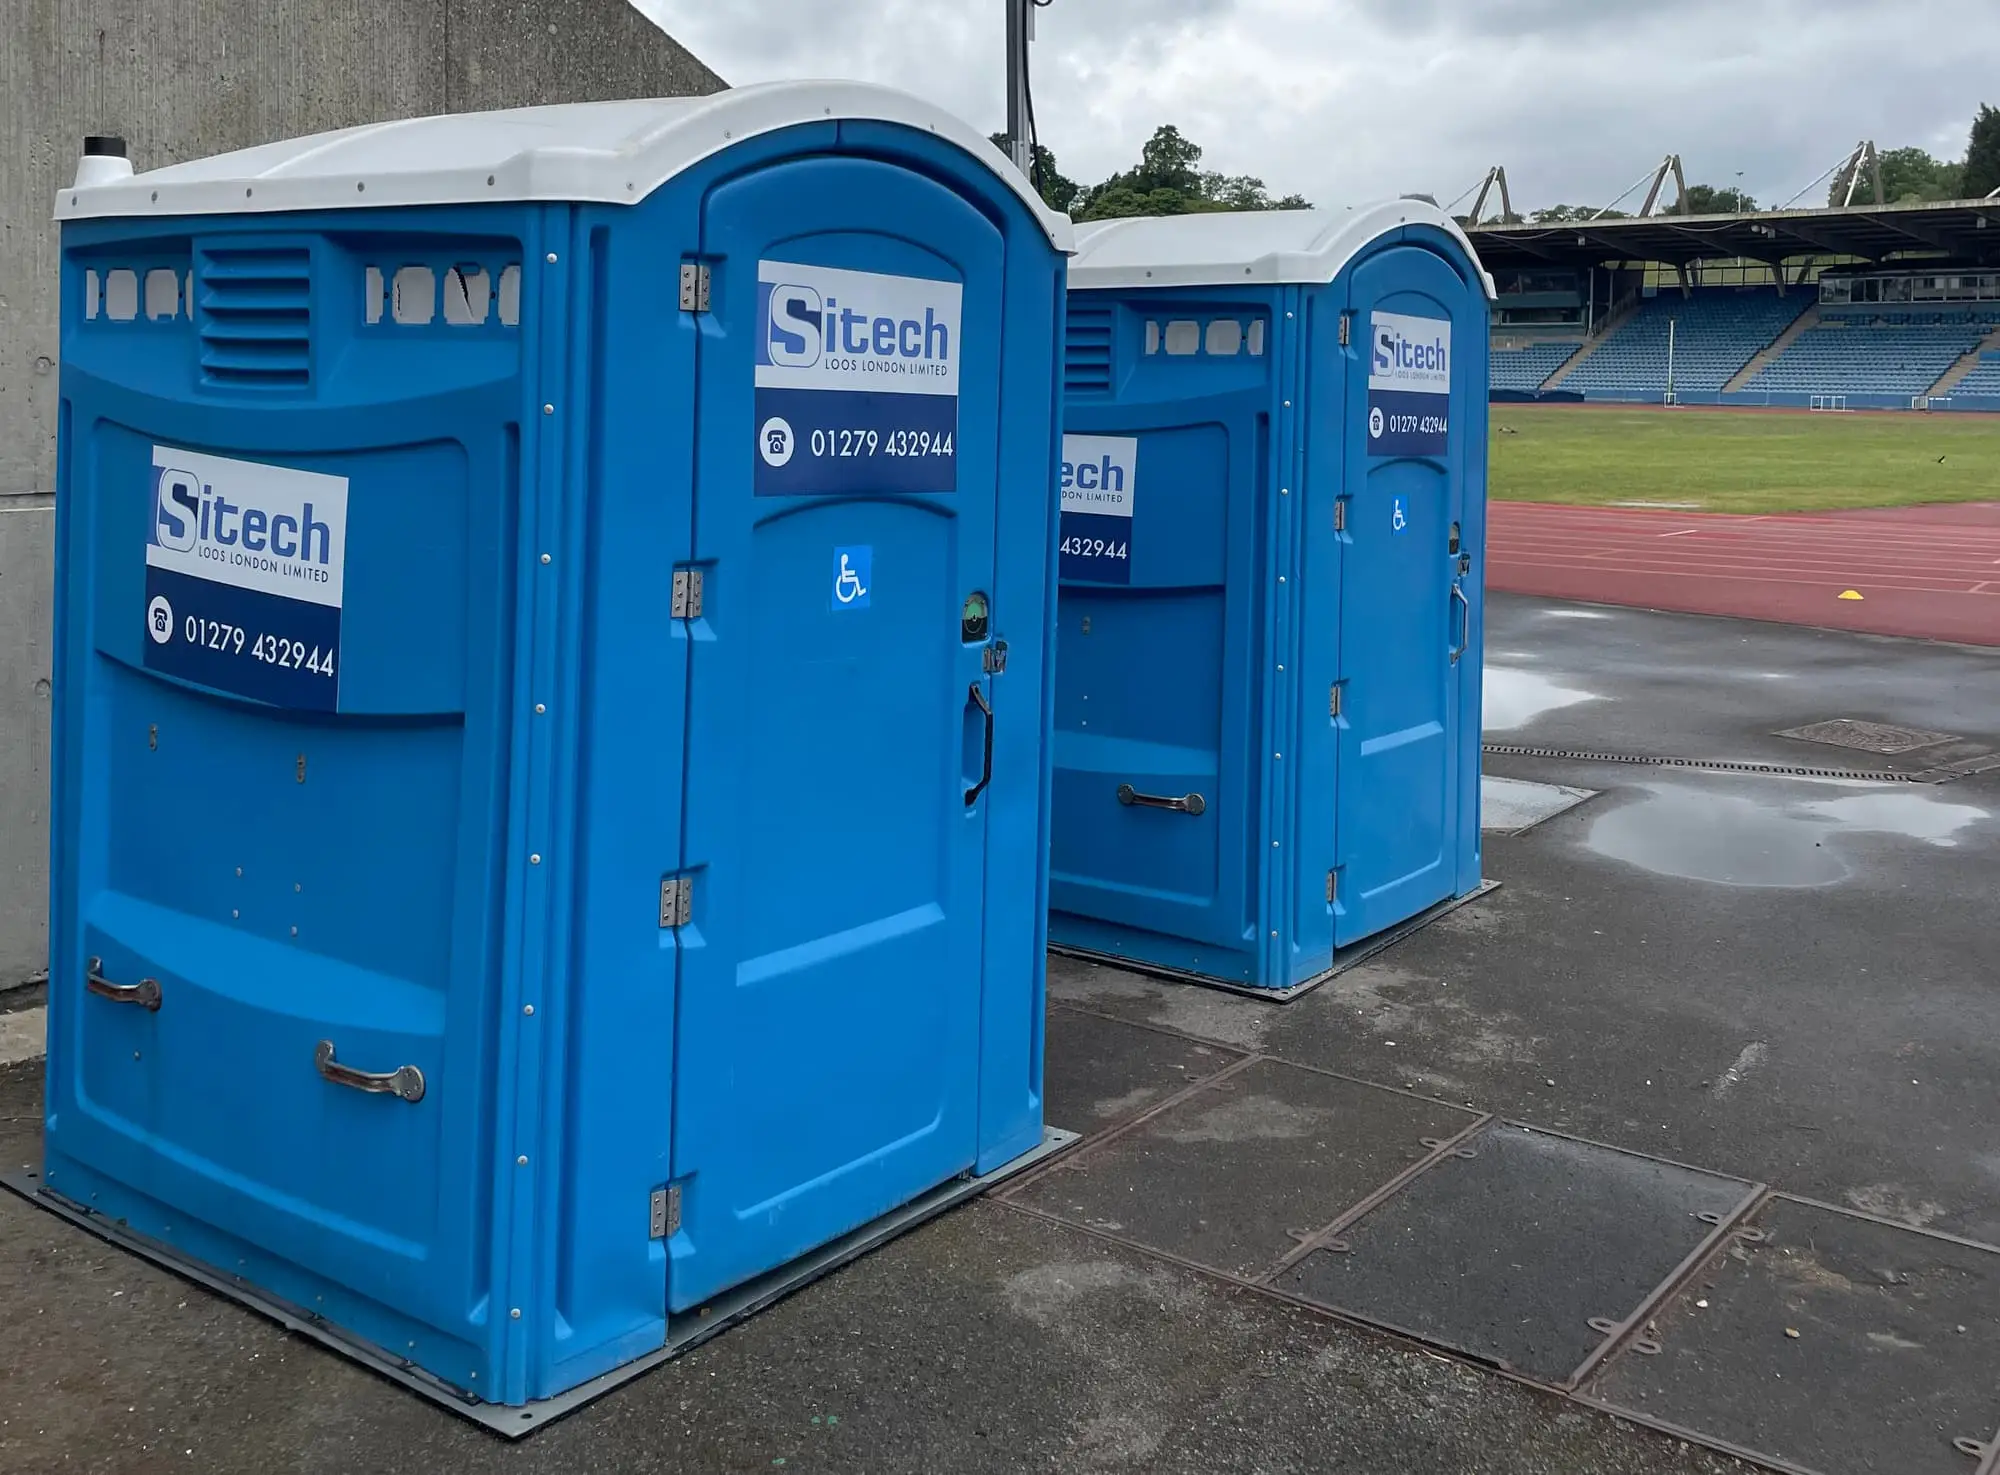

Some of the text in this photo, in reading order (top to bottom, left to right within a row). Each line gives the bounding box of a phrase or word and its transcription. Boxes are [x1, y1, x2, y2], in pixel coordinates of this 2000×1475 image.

[769, 283, 948, 368] Sitech
[825, 358, 947, 376] LOOS LONDON LIMITED
[1374, 325, 1446, 377] Sitech
[1390, 415, 1447, 433] 01279 432944
[811, 429, 953, 457] 01279 432944
[1086, 492, 1123, 503] LIMITED
[158, 467, 330, 565] Sitech
[199, 545, 329, 583] LOOS LONDON LIMITED
[1060, 536, 1127, 560] 432944
[185, 615, 334, 677] 01279 432944
